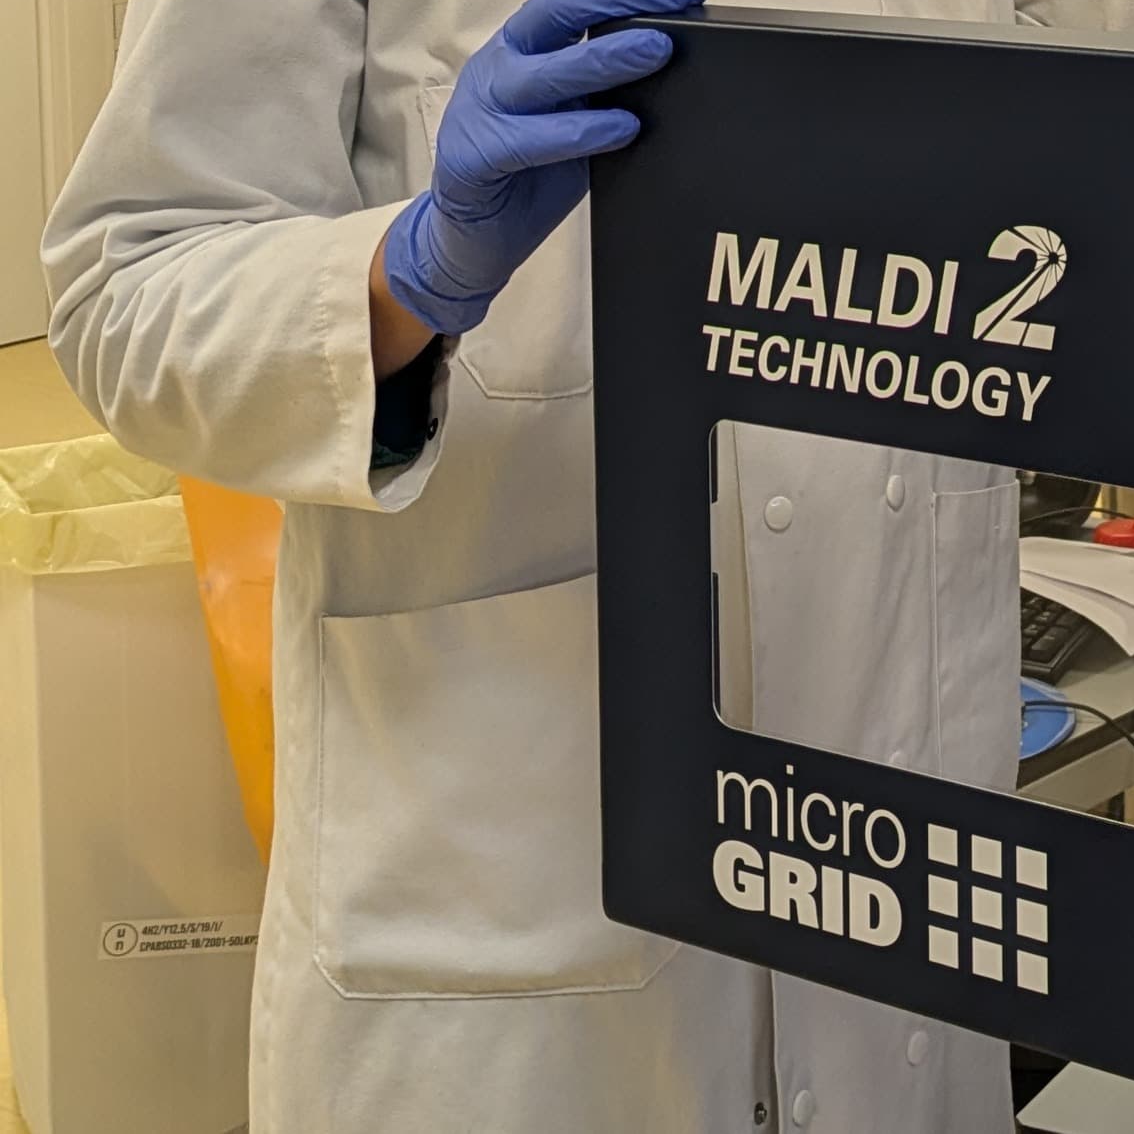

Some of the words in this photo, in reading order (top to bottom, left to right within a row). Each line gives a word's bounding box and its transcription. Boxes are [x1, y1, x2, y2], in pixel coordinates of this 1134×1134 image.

[707, 232, 959, 335] MALDI
[972, 225, 1068, 351] 2
[702, 324, 1052, 421] TECHNOLOGY
[716, 764, 906, 869] micro
[712, 839, 903, 947] GRID
